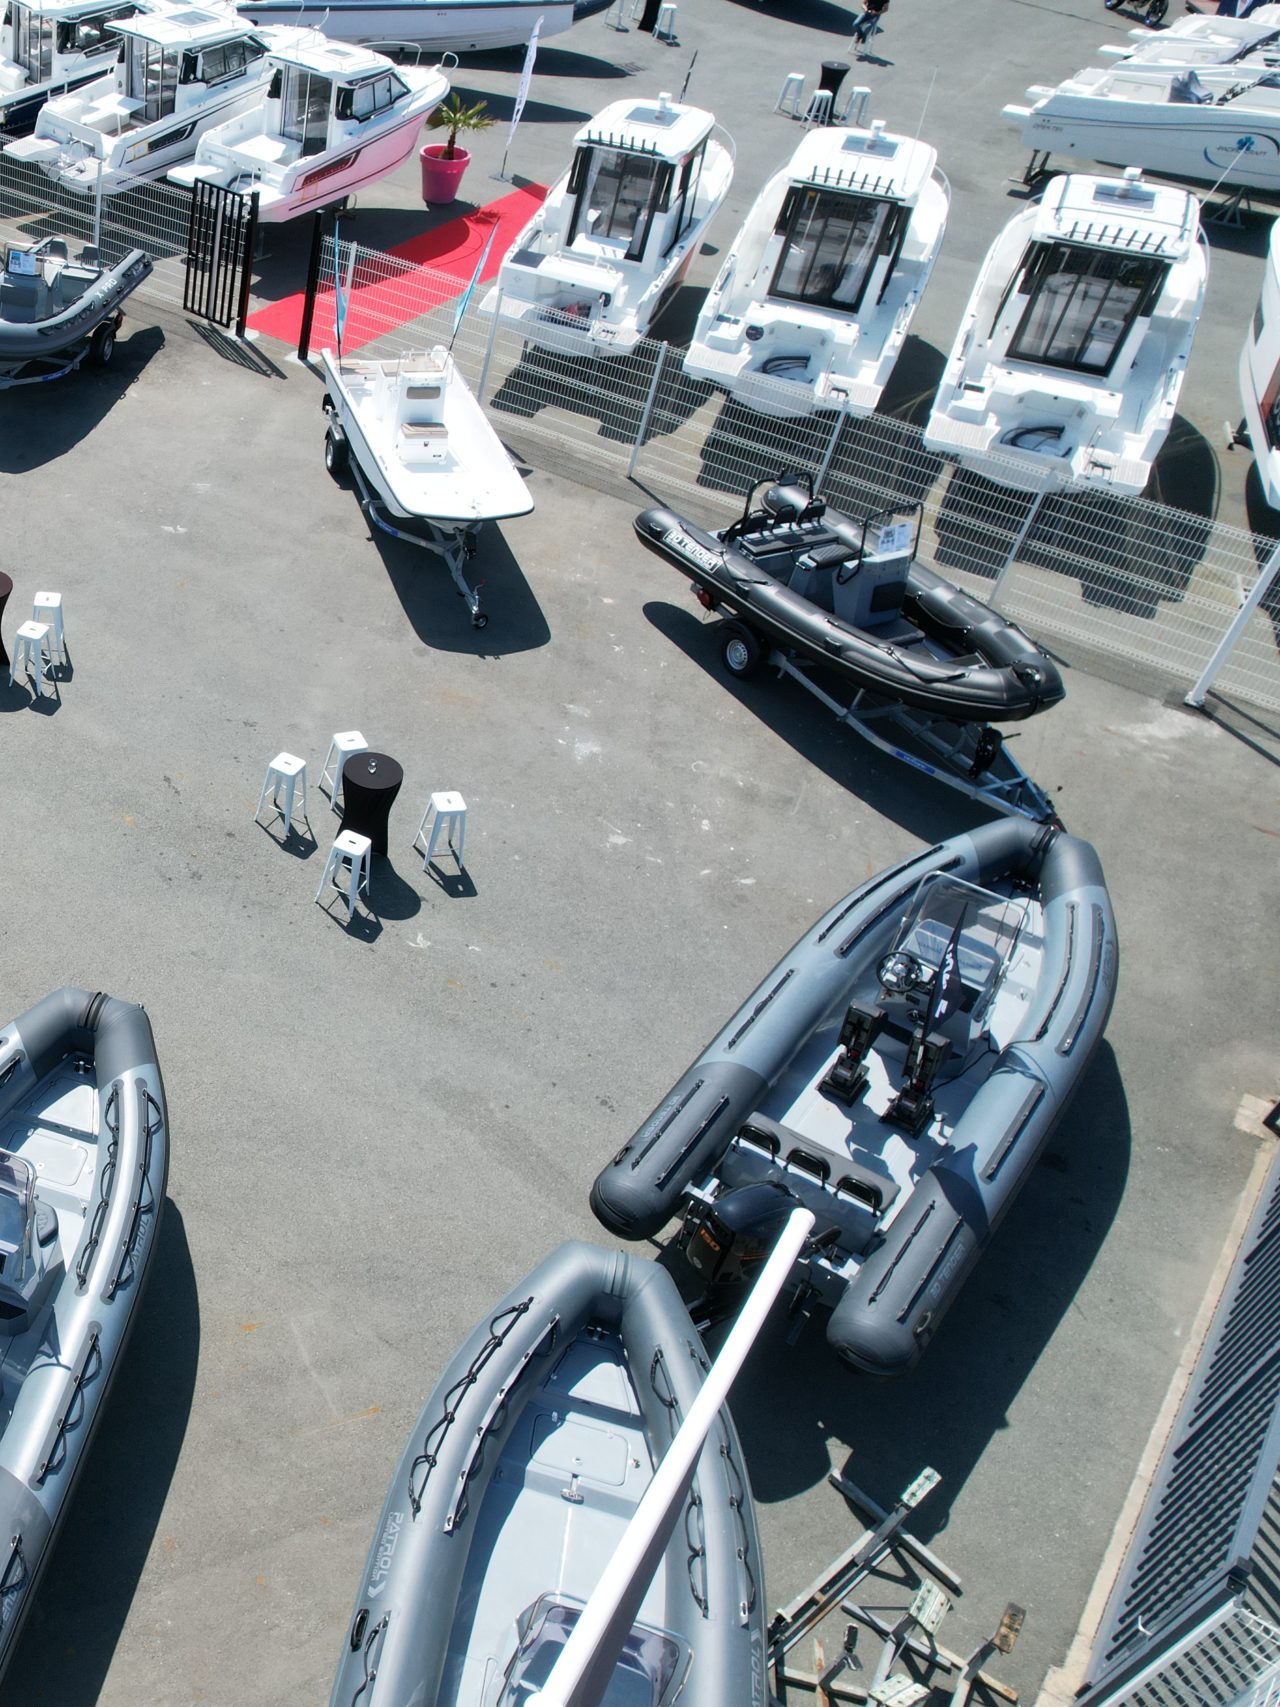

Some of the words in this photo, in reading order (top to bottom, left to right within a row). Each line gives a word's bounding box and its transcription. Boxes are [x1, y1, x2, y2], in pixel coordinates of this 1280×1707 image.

[102, 279, 117, 292] PRO
[682, 536, 718, 569] TENDER
[375, 1510, 404, 1582] PATROL
